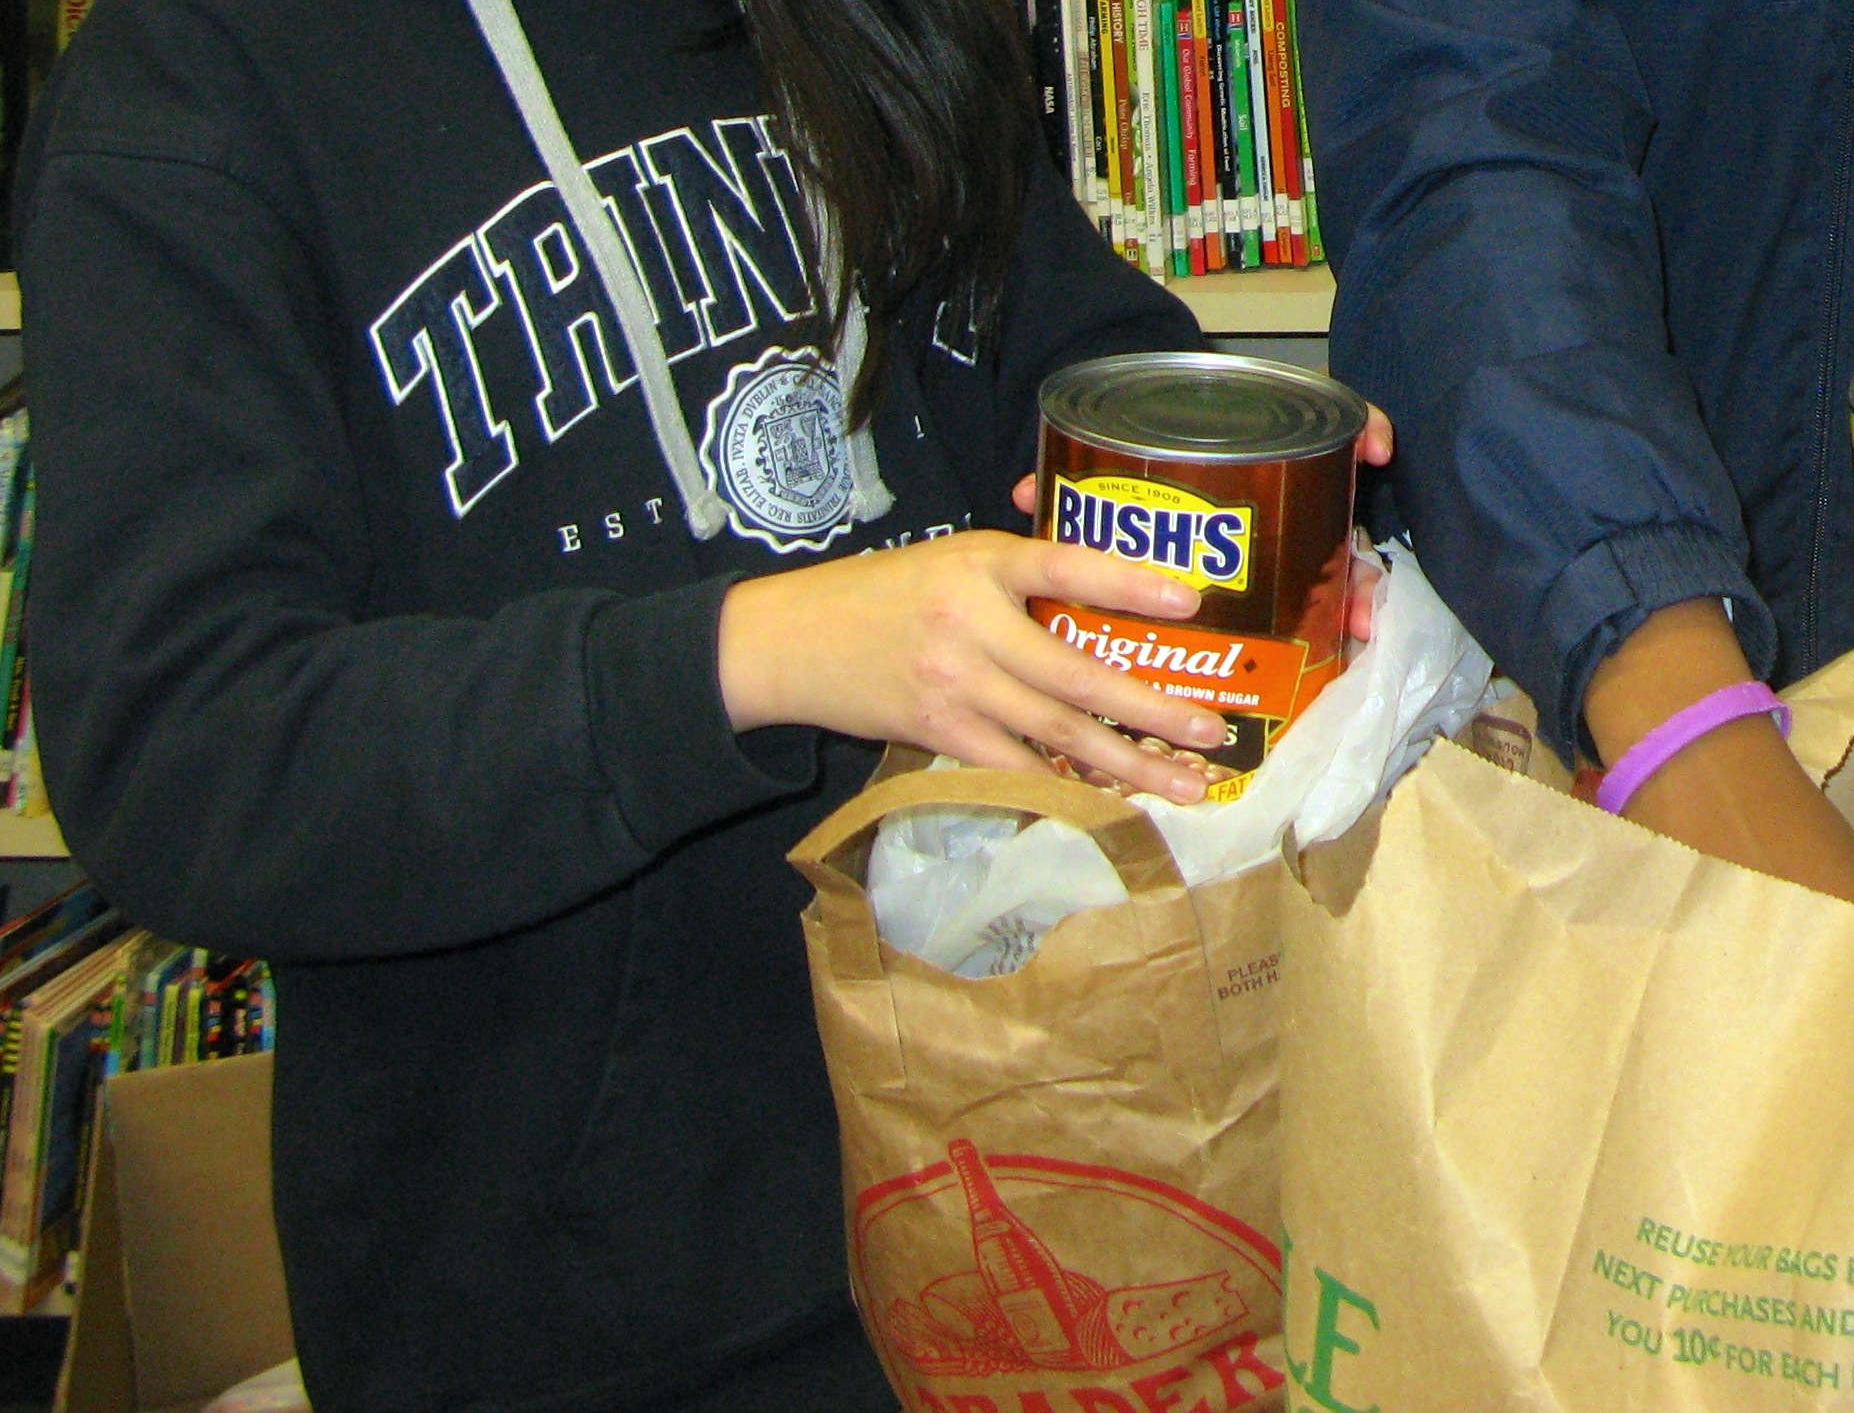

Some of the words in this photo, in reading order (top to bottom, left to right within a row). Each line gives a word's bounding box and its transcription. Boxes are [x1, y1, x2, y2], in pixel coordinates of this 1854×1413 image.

[1111, 2, 1123, 43] HISTORY
[1138, 21, 1148, 50] TIME
[1180, 48, 1188, 64] Our
[1276, 21, 1290, 108] COMPOSTING
[1182, 66, 1190, 92] Global
[1041, 85, 1056, 114] NASA
[1183, 95, 1194, 139] Community
[1187, 149, 1197, 186] Farming
[370, 114, 830, 519] TRIN
[743, 380, 777, 418] DVBLIN
[1098, 481, 1140, 495] SINCE
[1147, 487, 1181, 504] 1908
[558, 497, 666, 553] EST
[1058, 484, 1247, 581] BUSH'S
[1049, 613, 1245, 678] Original
[1165, 685, 1214, 700] BROWN
[1218, 690, 1260, 706] SUGAR
[1218, 776, 1248, 800] FAT
[1218, 974, 1263, 1000] BOTH
[1636, 1216, 1724, 1268] REUSE
[1725, 1242, 1773, 1271] YOUR
[1776, 1246, 1839, 1282] BAGS
[1592, 1248, 1664, 1300] NEXT
[1667, 1284, 1798, 1327] PURCHASES
[1606, 1309, 1663, 1356] YOU
[1673, 1327, 1721, 1366] 10¢
[1725, 1343, 1774, 1377] FOR
[1781, 1352, 1840, 1388] EACH
